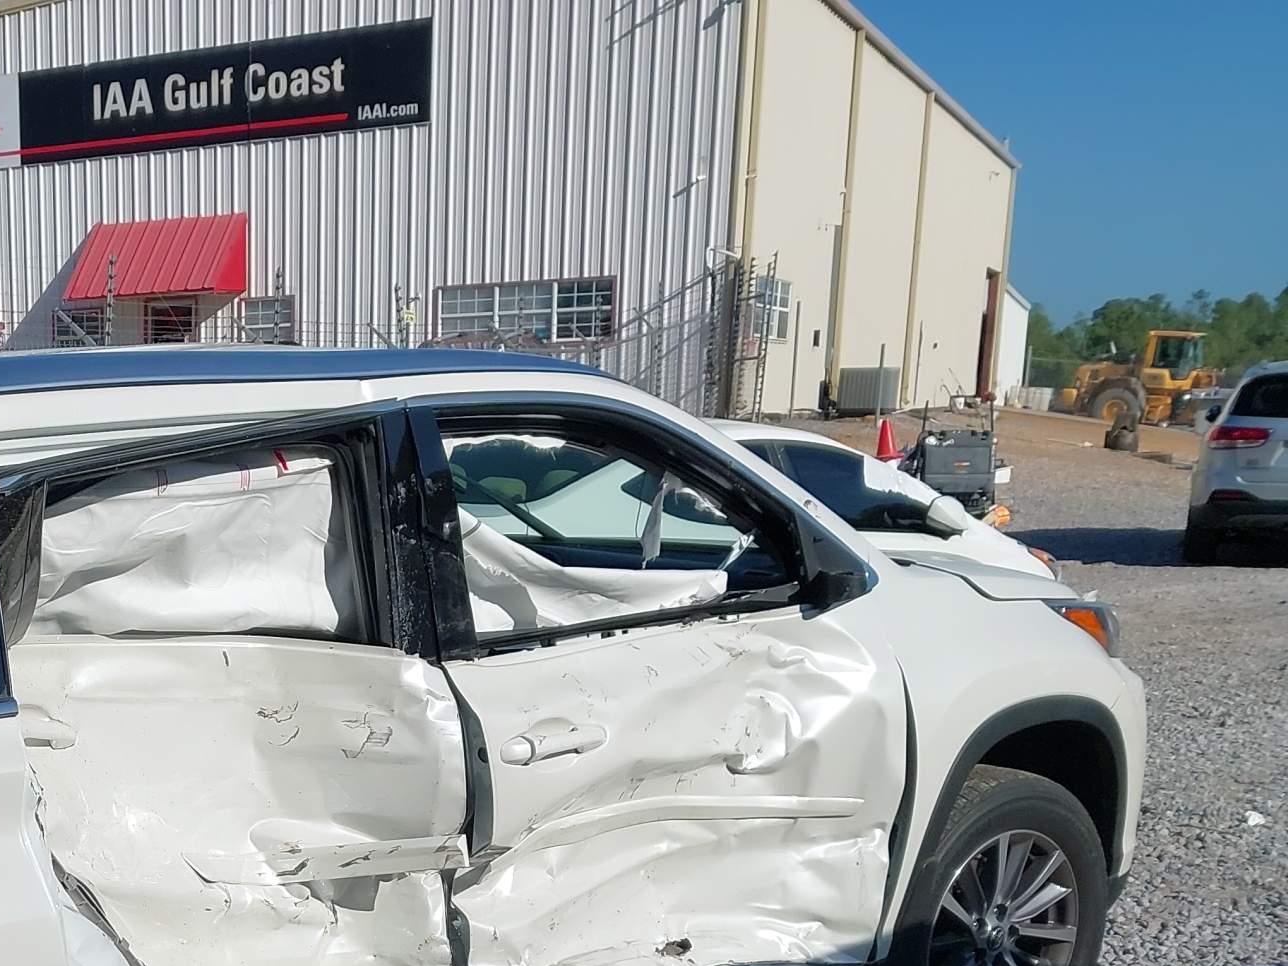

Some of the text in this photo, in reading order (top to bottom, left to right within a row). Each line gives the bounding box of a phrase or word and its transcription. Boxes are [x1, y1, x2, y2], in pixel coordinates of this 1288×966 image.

[93, 57, 345, 121] IAA Gulf Coast
[357, 102, 419, 121] IAAI.com
